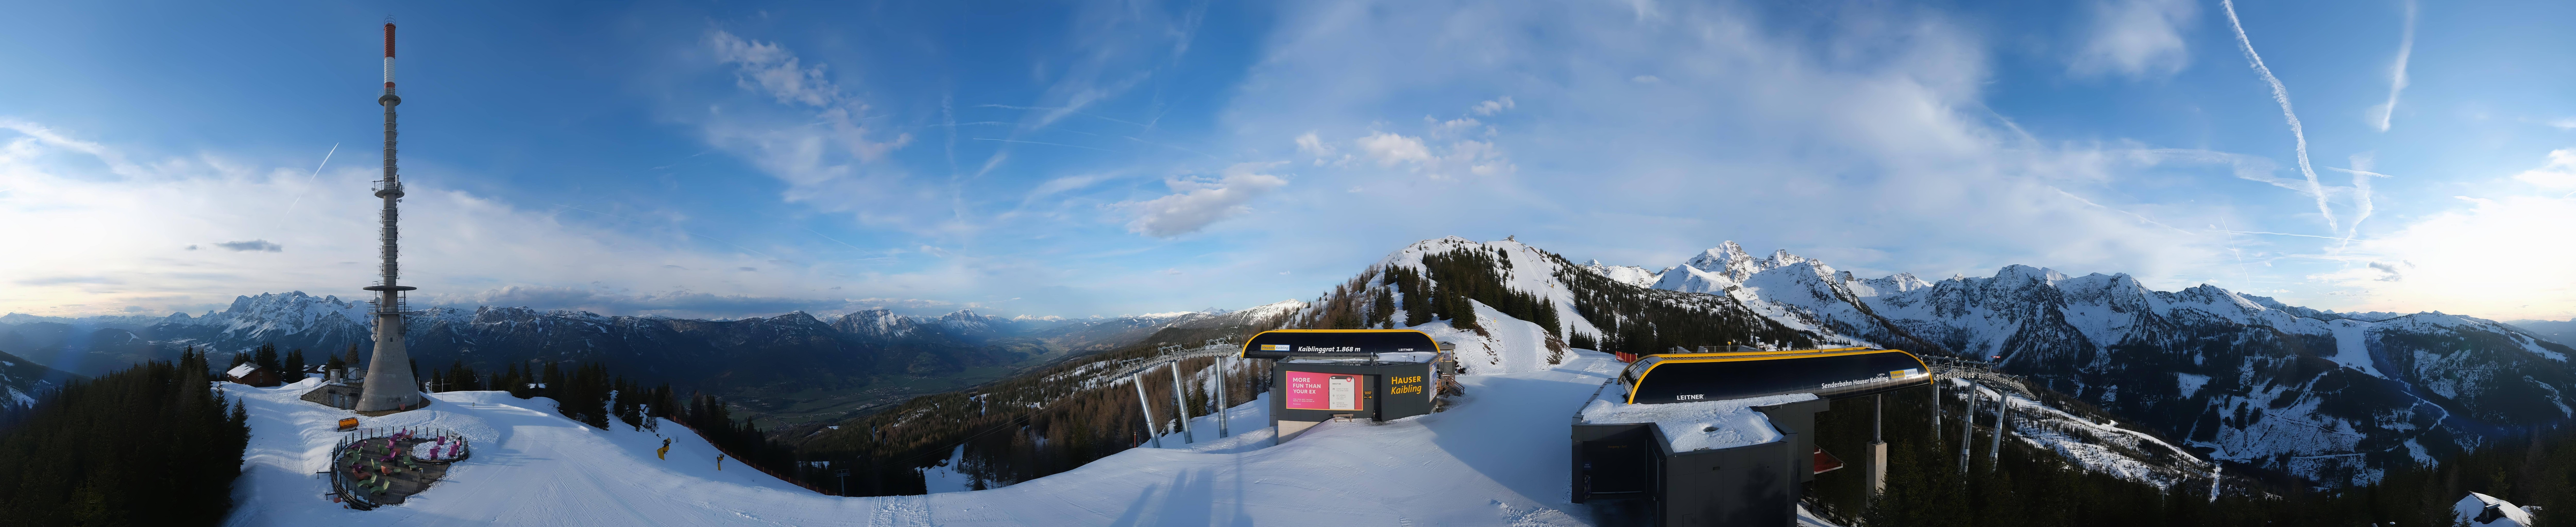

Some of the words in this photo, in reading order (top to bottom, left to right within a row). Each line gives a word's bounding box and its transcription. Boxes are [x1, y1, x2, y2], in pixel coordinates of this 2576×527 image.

[1392, 376, 1421, 385] HAUSER
[1822, 380, 1852, 389] Senderbahn
[1391, 385, 1422, 395] Kaibling
